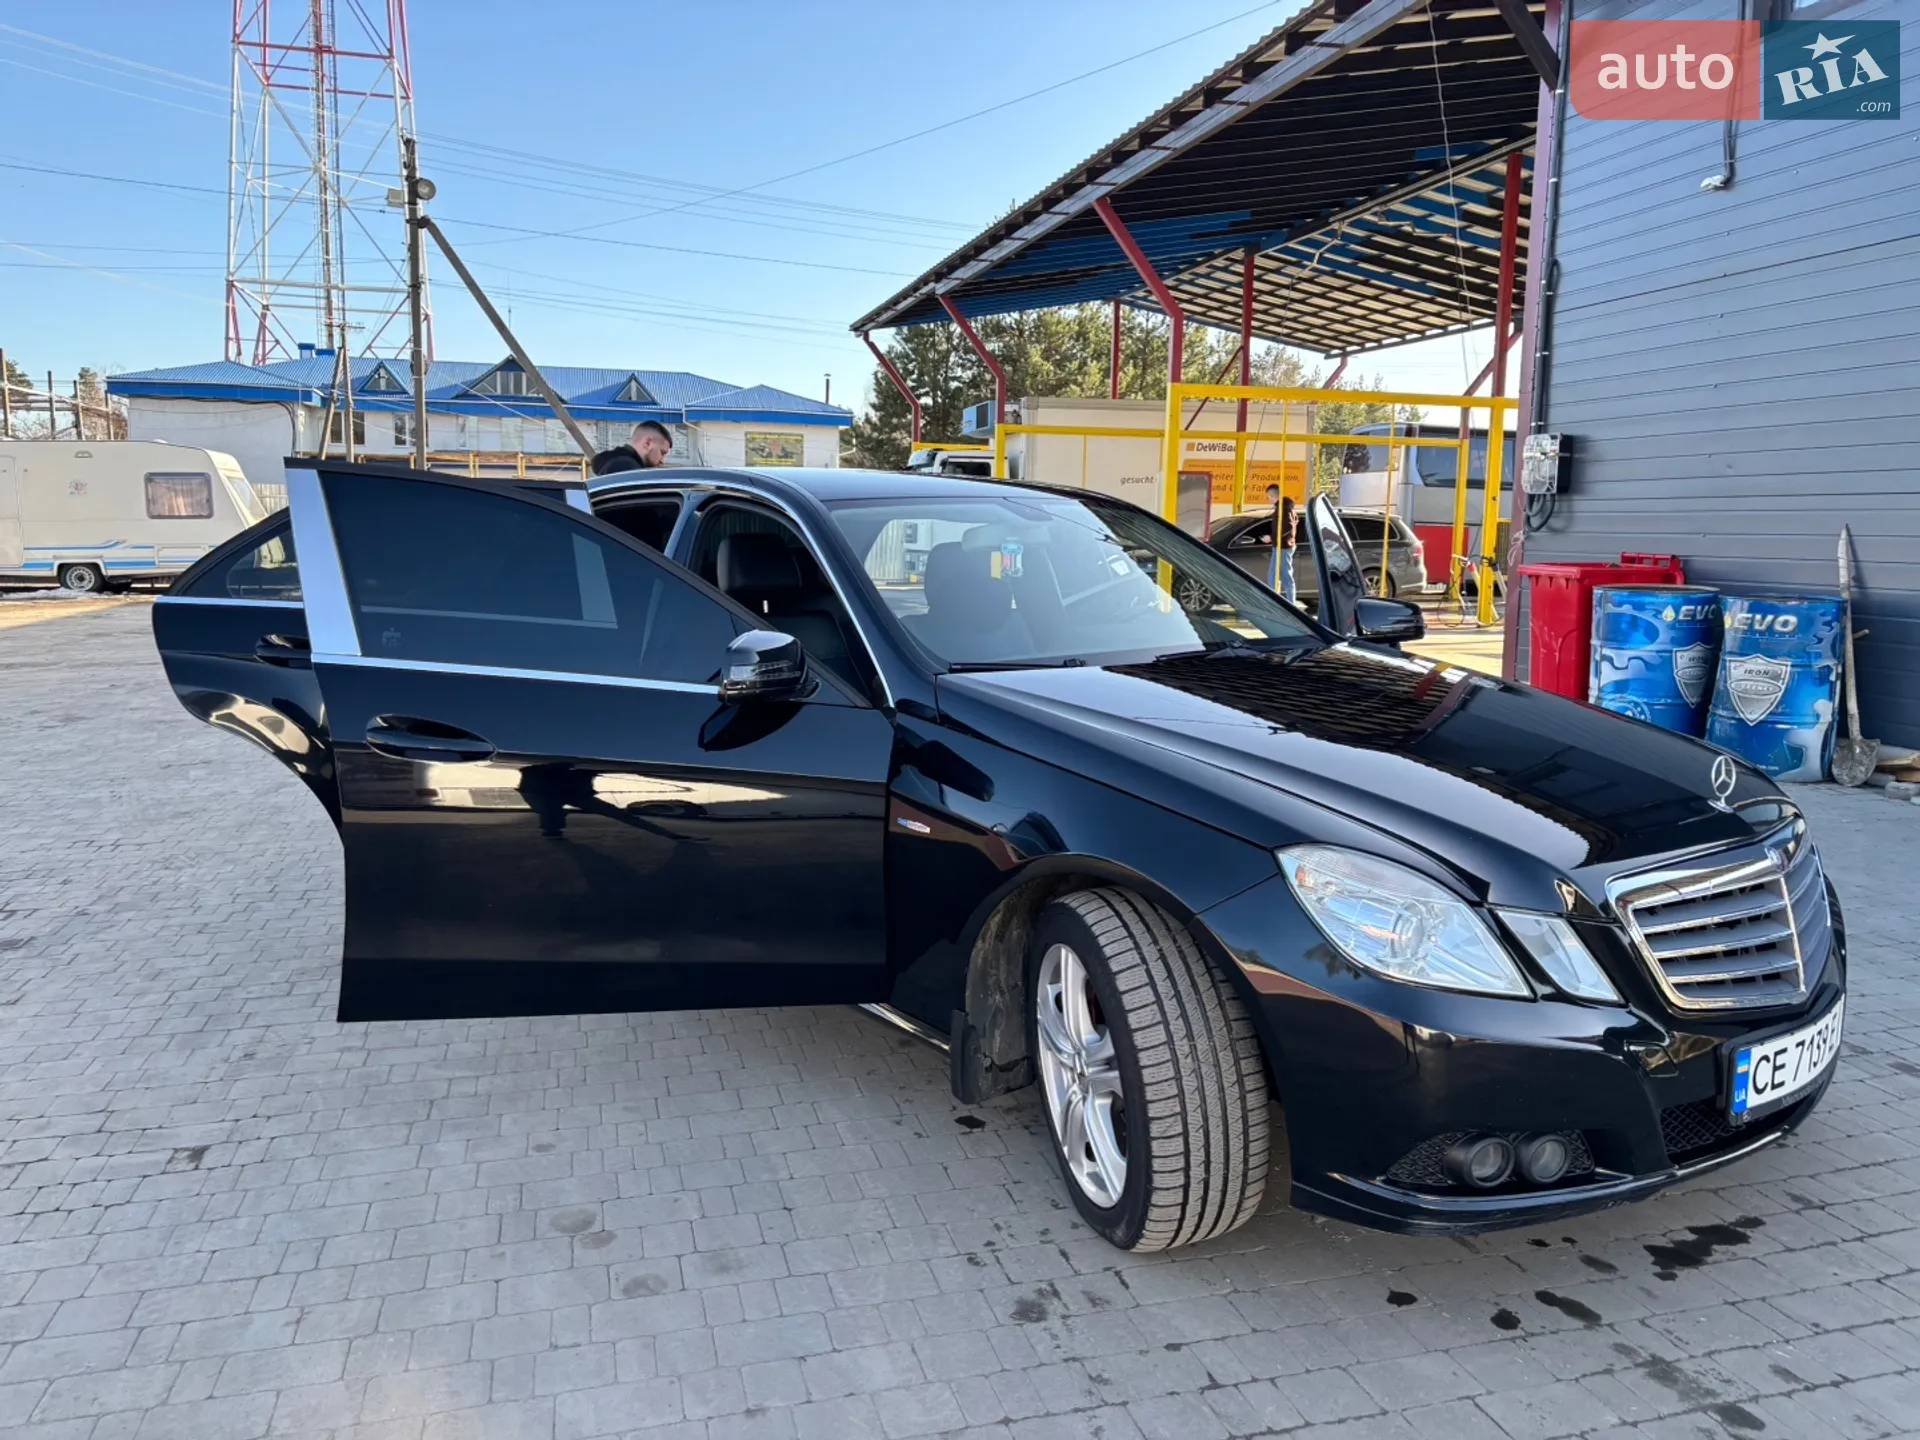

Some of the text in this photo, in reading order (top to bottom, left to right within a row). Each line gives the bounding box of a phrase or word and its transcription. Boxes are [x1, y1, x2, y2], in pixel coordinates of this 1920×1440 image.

[1734, 613, 1798, 632] EVO
[1752, 1047, 1788, 1095] CE
[1734, 1088, 1747, 1103] UA
